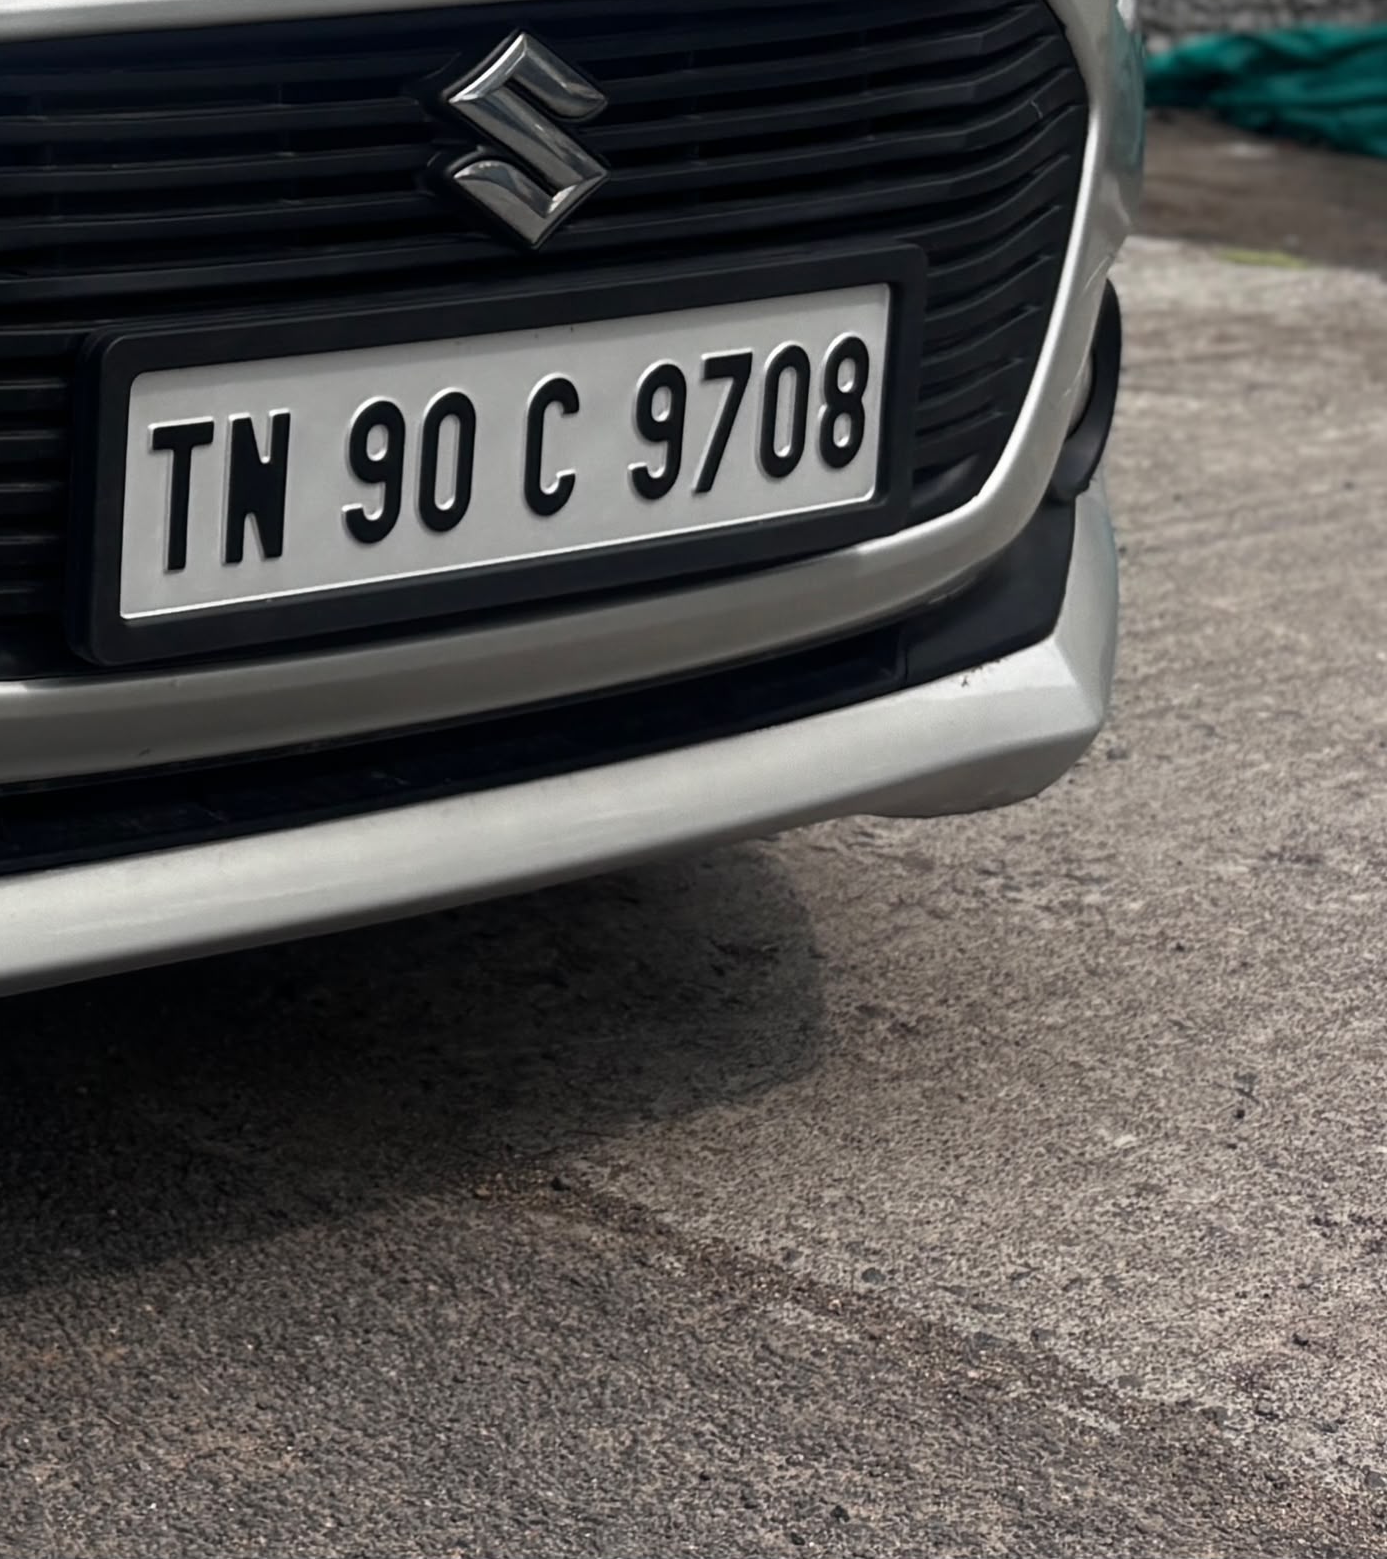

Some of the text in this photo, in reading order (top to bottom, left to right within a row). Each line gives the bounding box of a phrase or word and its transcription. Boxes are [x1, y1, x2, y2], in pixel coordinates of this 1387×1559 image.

[148, 331, 871, 571] TN 90 C 9708
